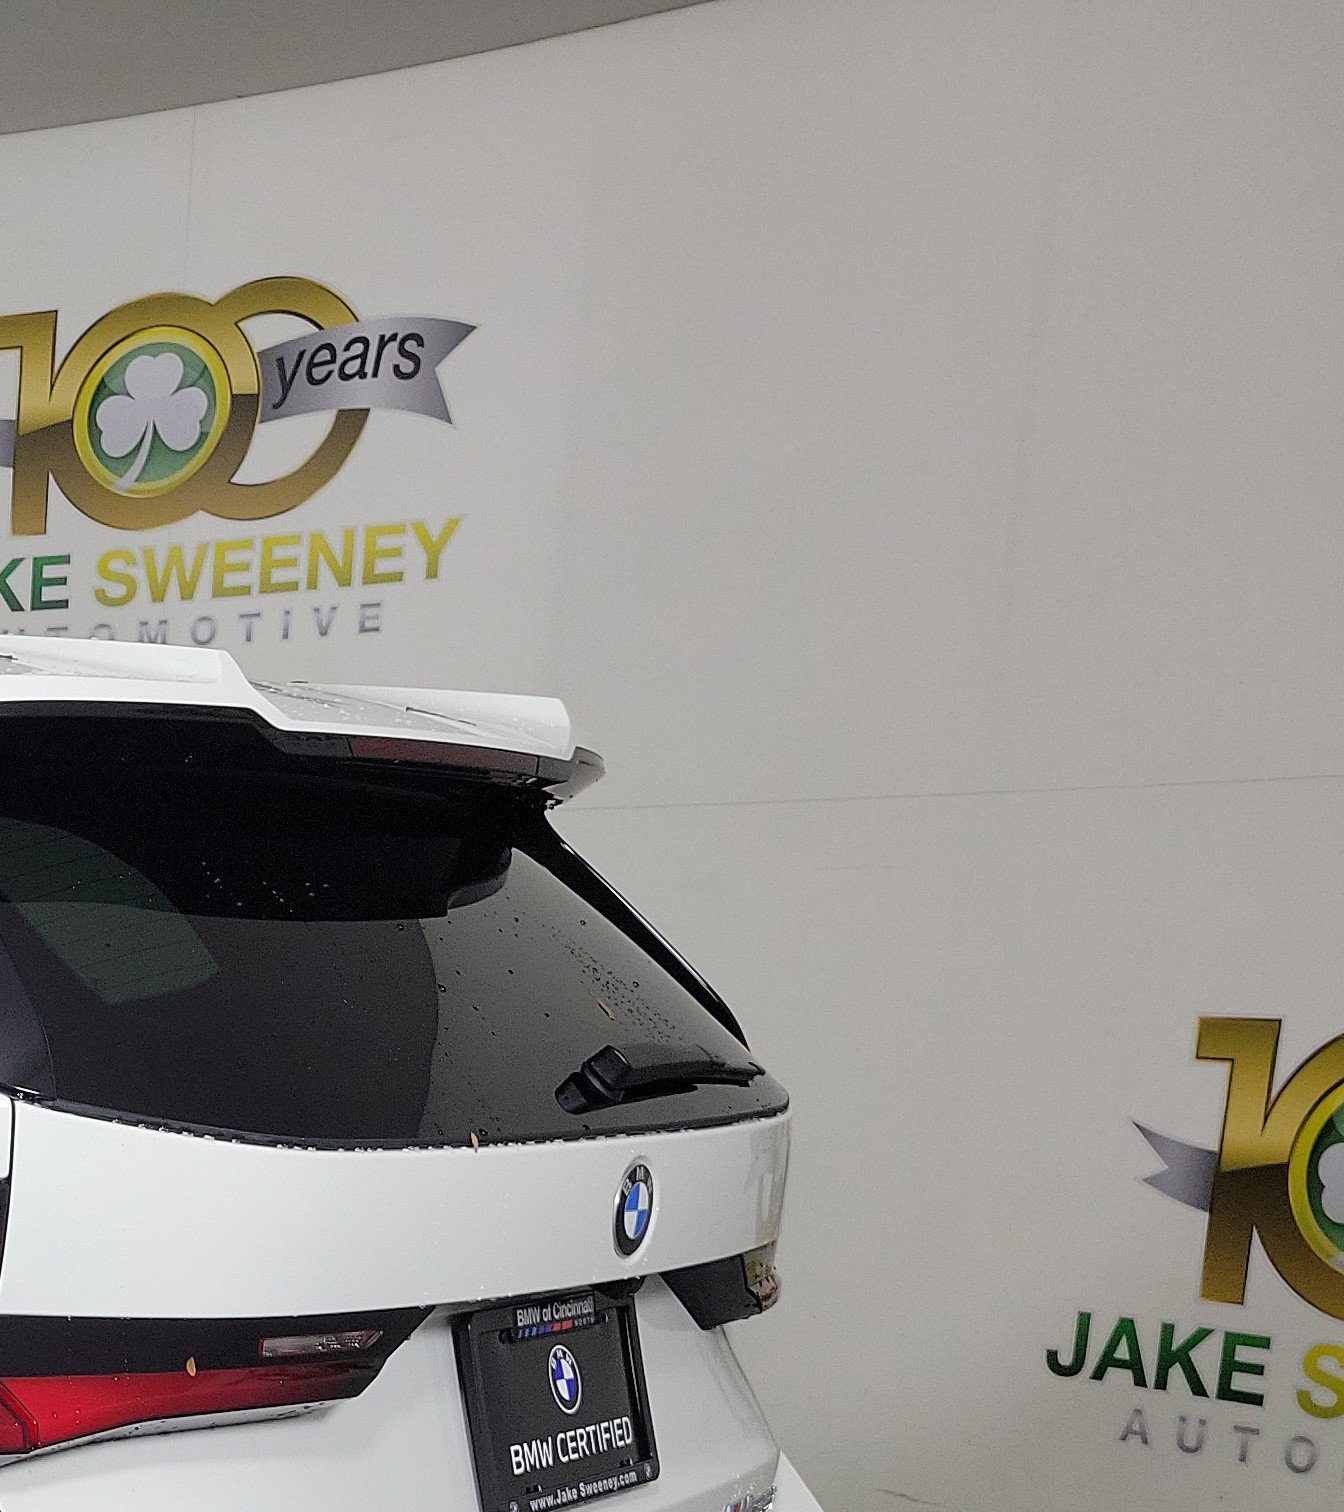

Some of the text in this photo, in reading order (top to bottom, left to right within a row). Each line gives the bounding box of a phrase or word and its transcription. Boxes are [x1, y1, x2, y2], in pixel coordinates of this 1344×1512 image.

[272, 329, 425, 409] years
[93, 513, 464, 608] SWEENEY
[516, 1306, 541, 1326] BMW
[542, 1303, 552, 1322] of
[1045, 1311, 1344, 1420] JAKE S
[510, 1416, 633, 1476] BMW CERTIFIED
[1119, 1407, 1320, 1475] AUTO
[529, 1470, 638, 1512] www.Jake Sweeney.com
